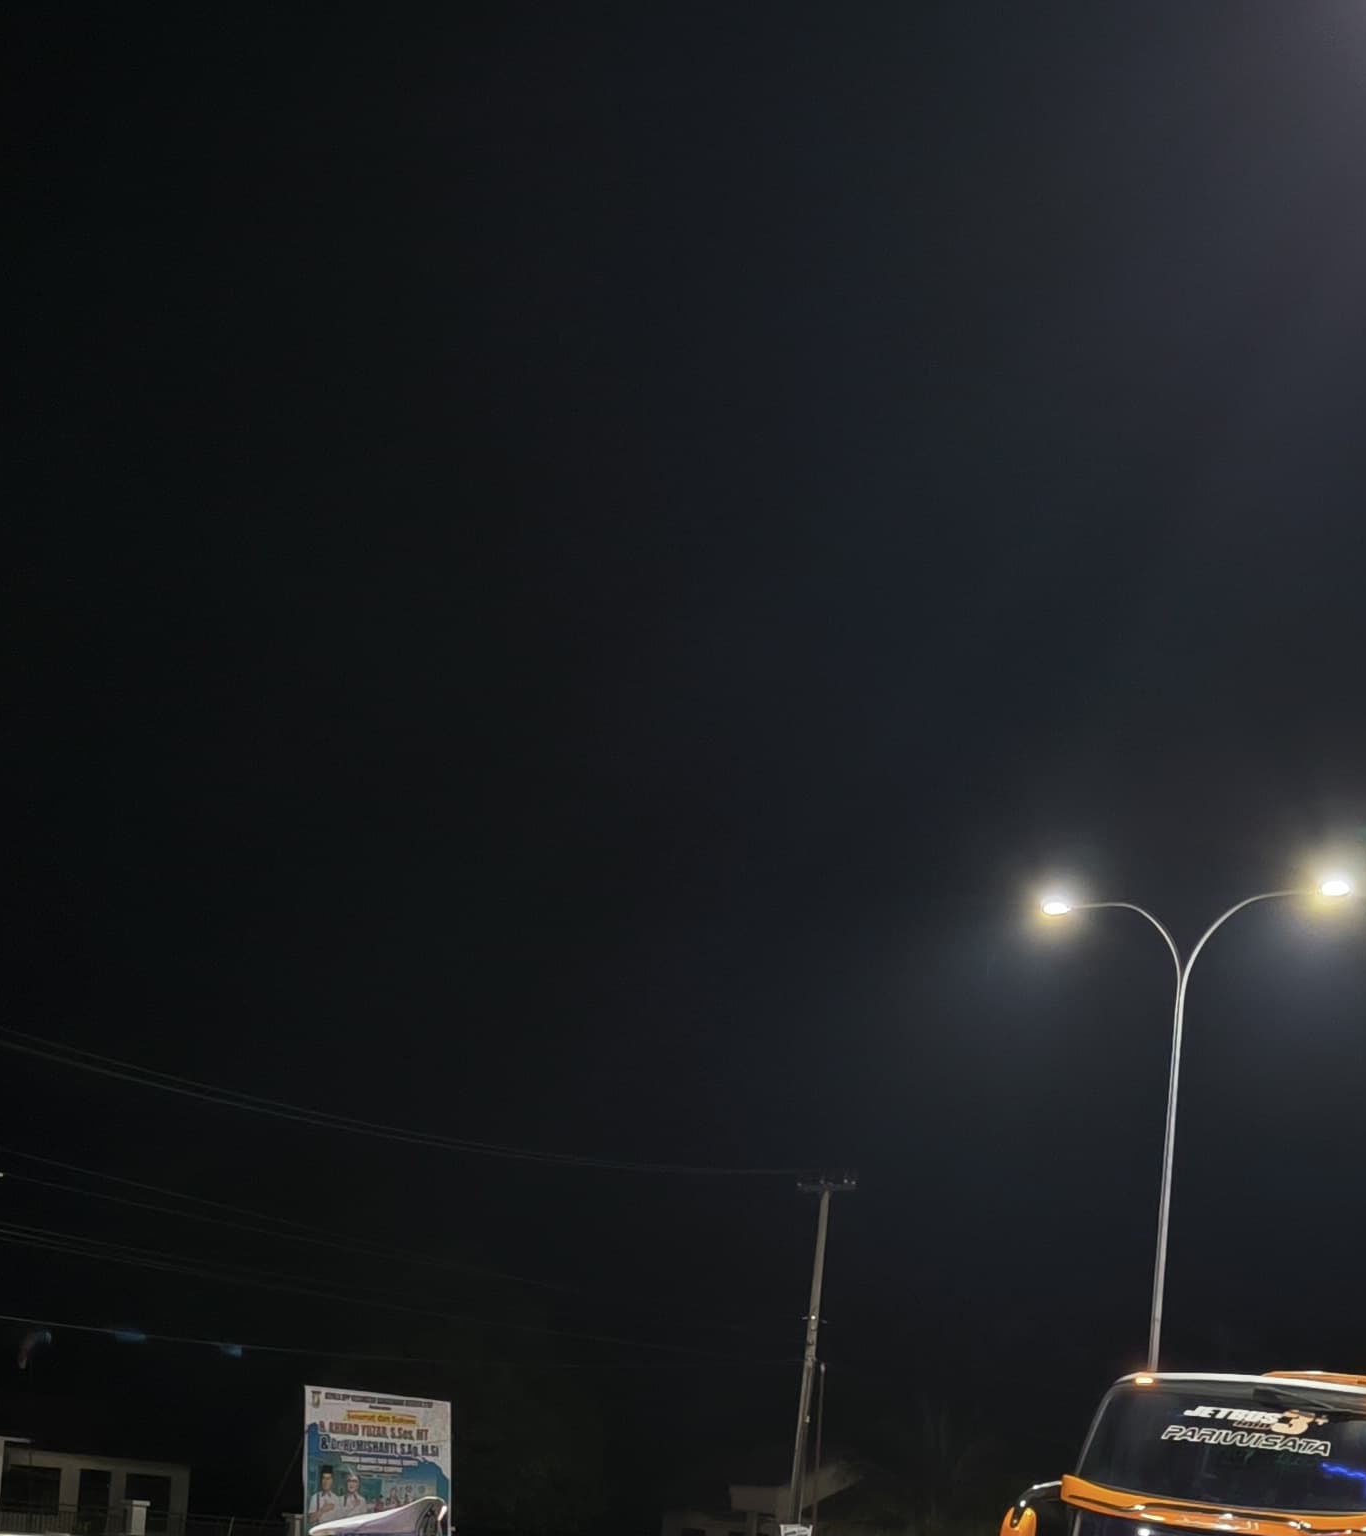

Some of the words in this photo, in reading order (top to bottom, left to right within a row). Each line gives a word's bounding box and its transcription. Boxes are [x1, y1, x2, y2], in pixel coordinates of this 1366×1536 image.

[1183, 1405, 1282, 1424] JETBUS
[321, 1436, 329, 1450] &
[1161, 1424, 1332, 1457] PARIWISATA
